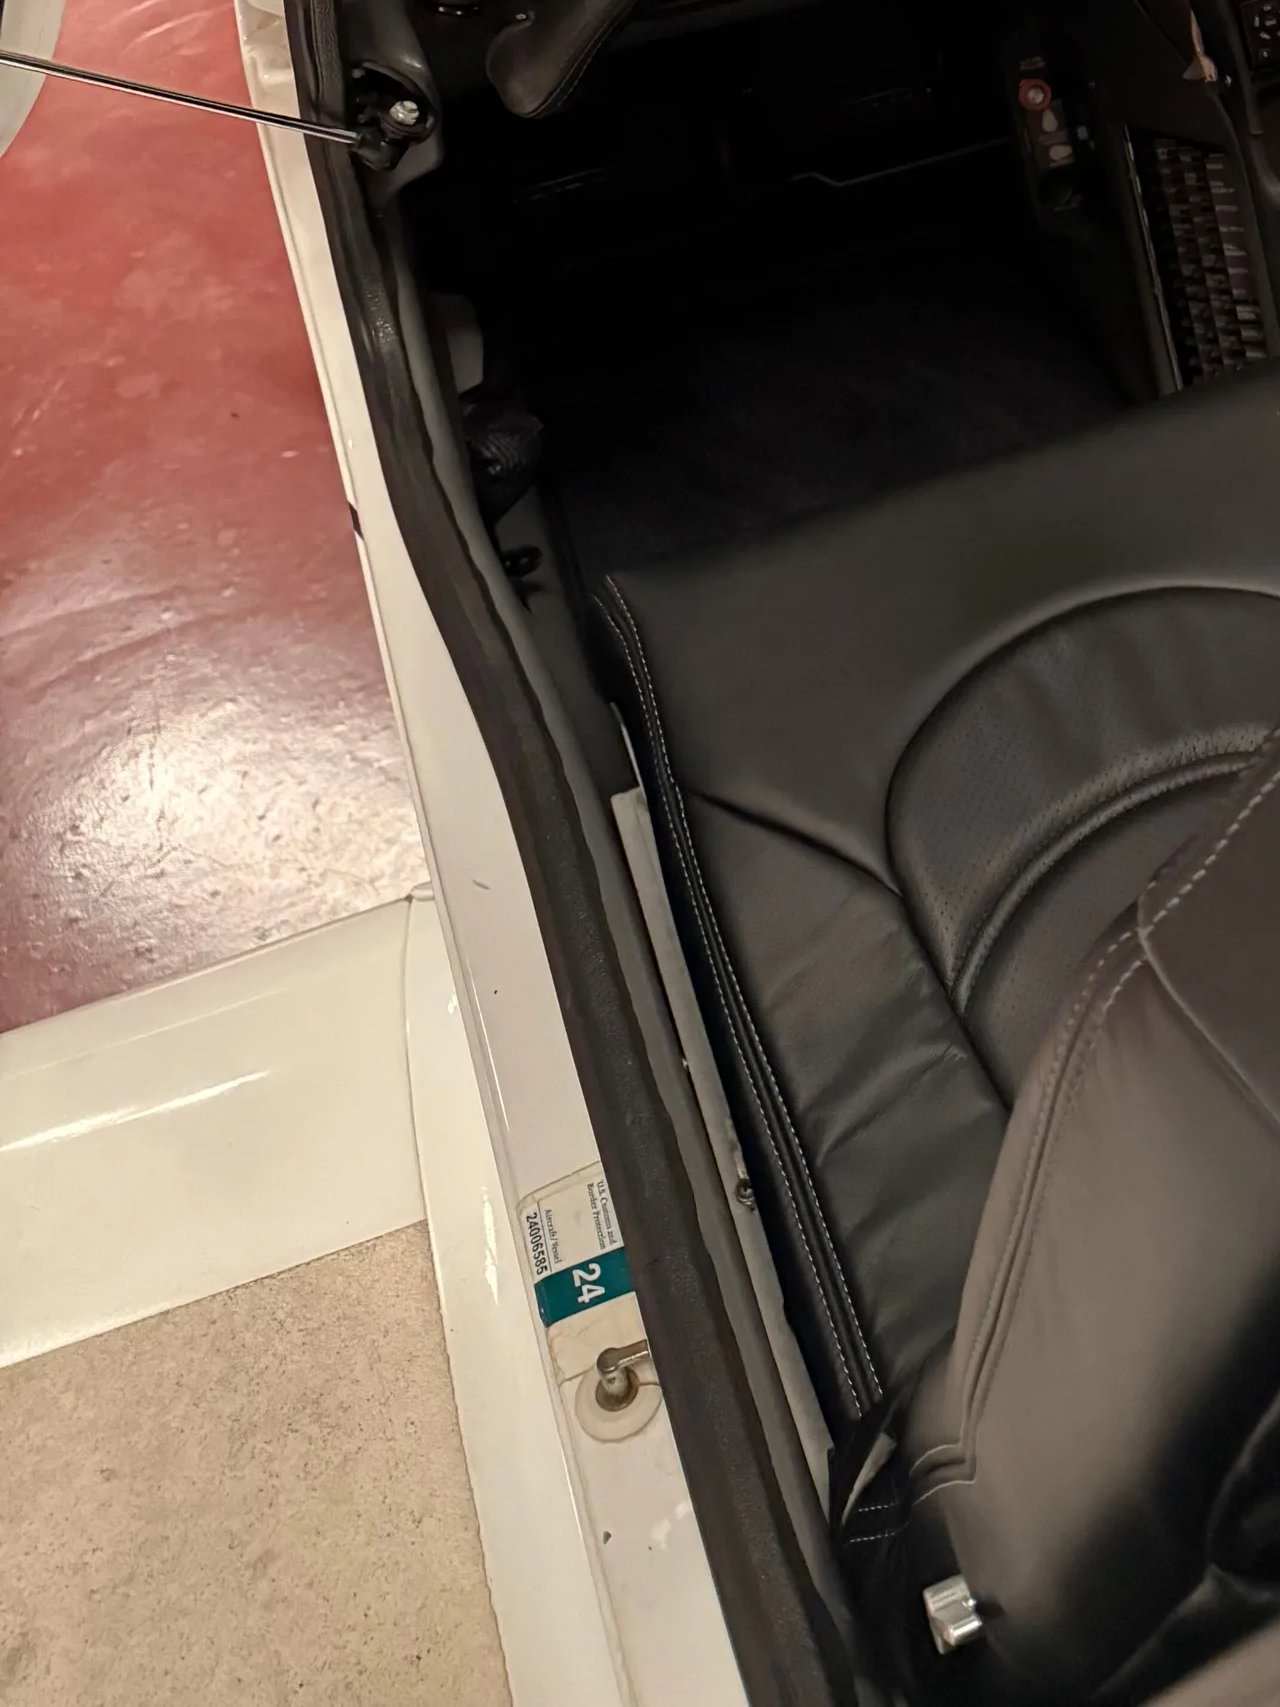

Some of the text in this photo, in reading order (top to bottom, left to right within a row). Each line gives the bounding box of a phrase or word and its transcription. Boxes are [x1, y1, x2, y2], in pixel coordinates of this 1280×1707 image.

[526, 1212, 548, 1275] 24006585
[587, 1183, 606, 1250] Border Protection
[599, 1195, 612, 1231] Customs
[607, 1231, 618, 1245] and
[572, 1263, 606, 1304] 24
